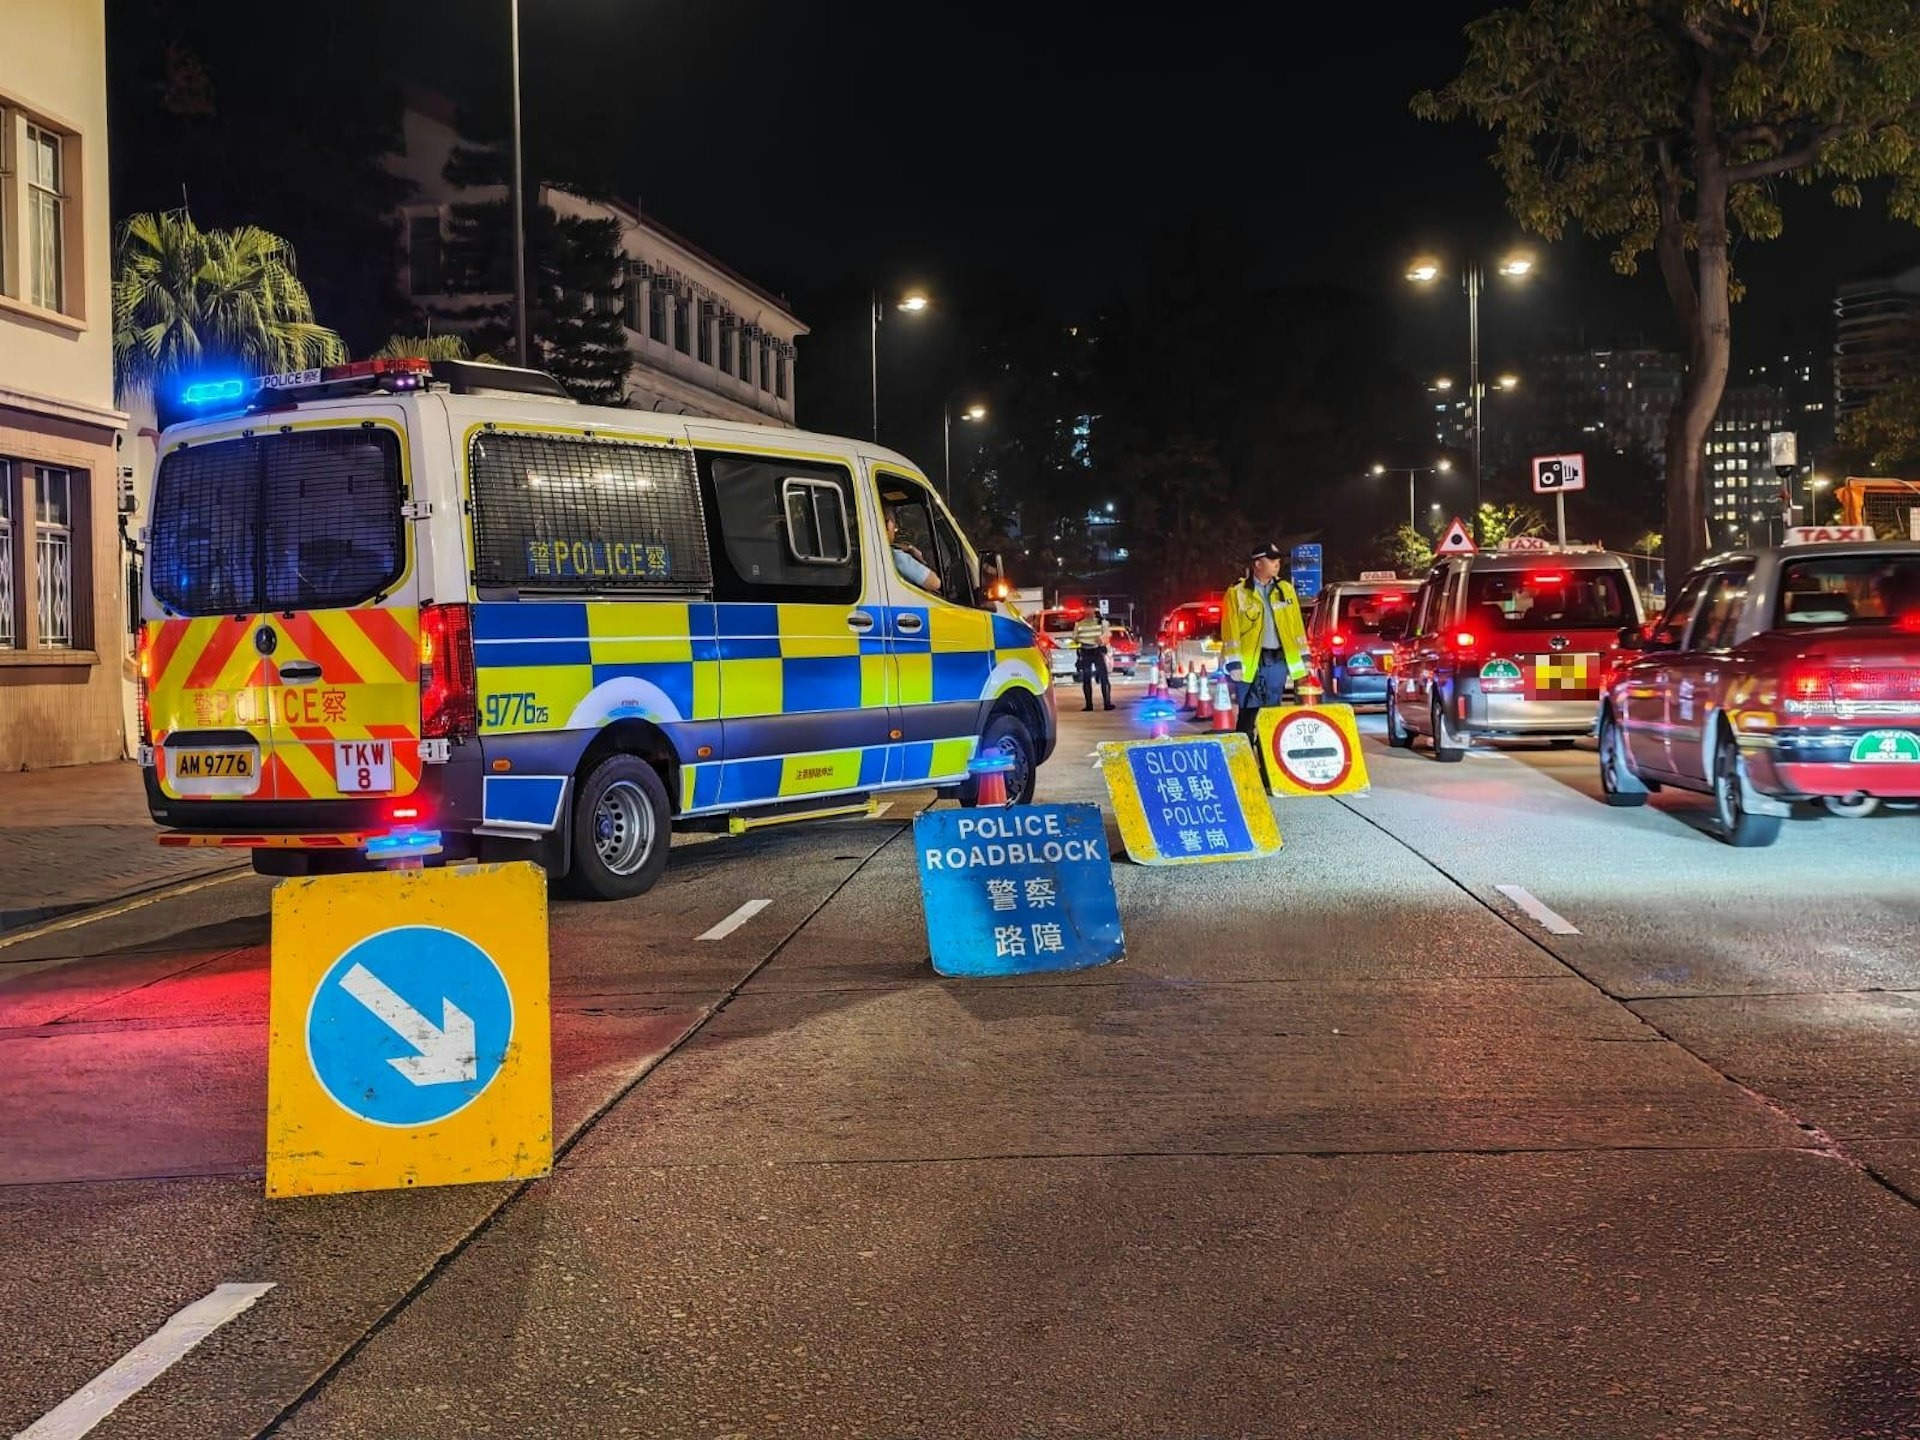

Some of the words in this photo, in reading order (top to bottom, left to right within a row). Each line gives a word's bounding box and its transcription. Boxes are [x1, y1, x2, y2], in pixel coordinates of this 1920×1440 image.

[264, 373, 302, 388] POLICE
[1507, 538, 1544, 550] TAXI
[1797, 529, 1865, 541] TAXI
[486, 692, 536, 727] 9776
[1296, 722, 1320, 735] STOP
[180, 756, 200, 774] AM
[205, 754, 247, 774] 9776
[340, 743, 385, 766] TKW
[1145, 748, 1209, 775] SLOW
[358, 768, 371, 789] 8
[1157, 774, 1219, 804] 慢駛
[1162, 803, 1228, 826] POLICE
[958, 814, 1062, 840] POLICE
[925, 839, 1102, 870] ROADBLOCK
[986, 877, 1056, 911] 警察
[994, 922, 1065, 957] 路障
